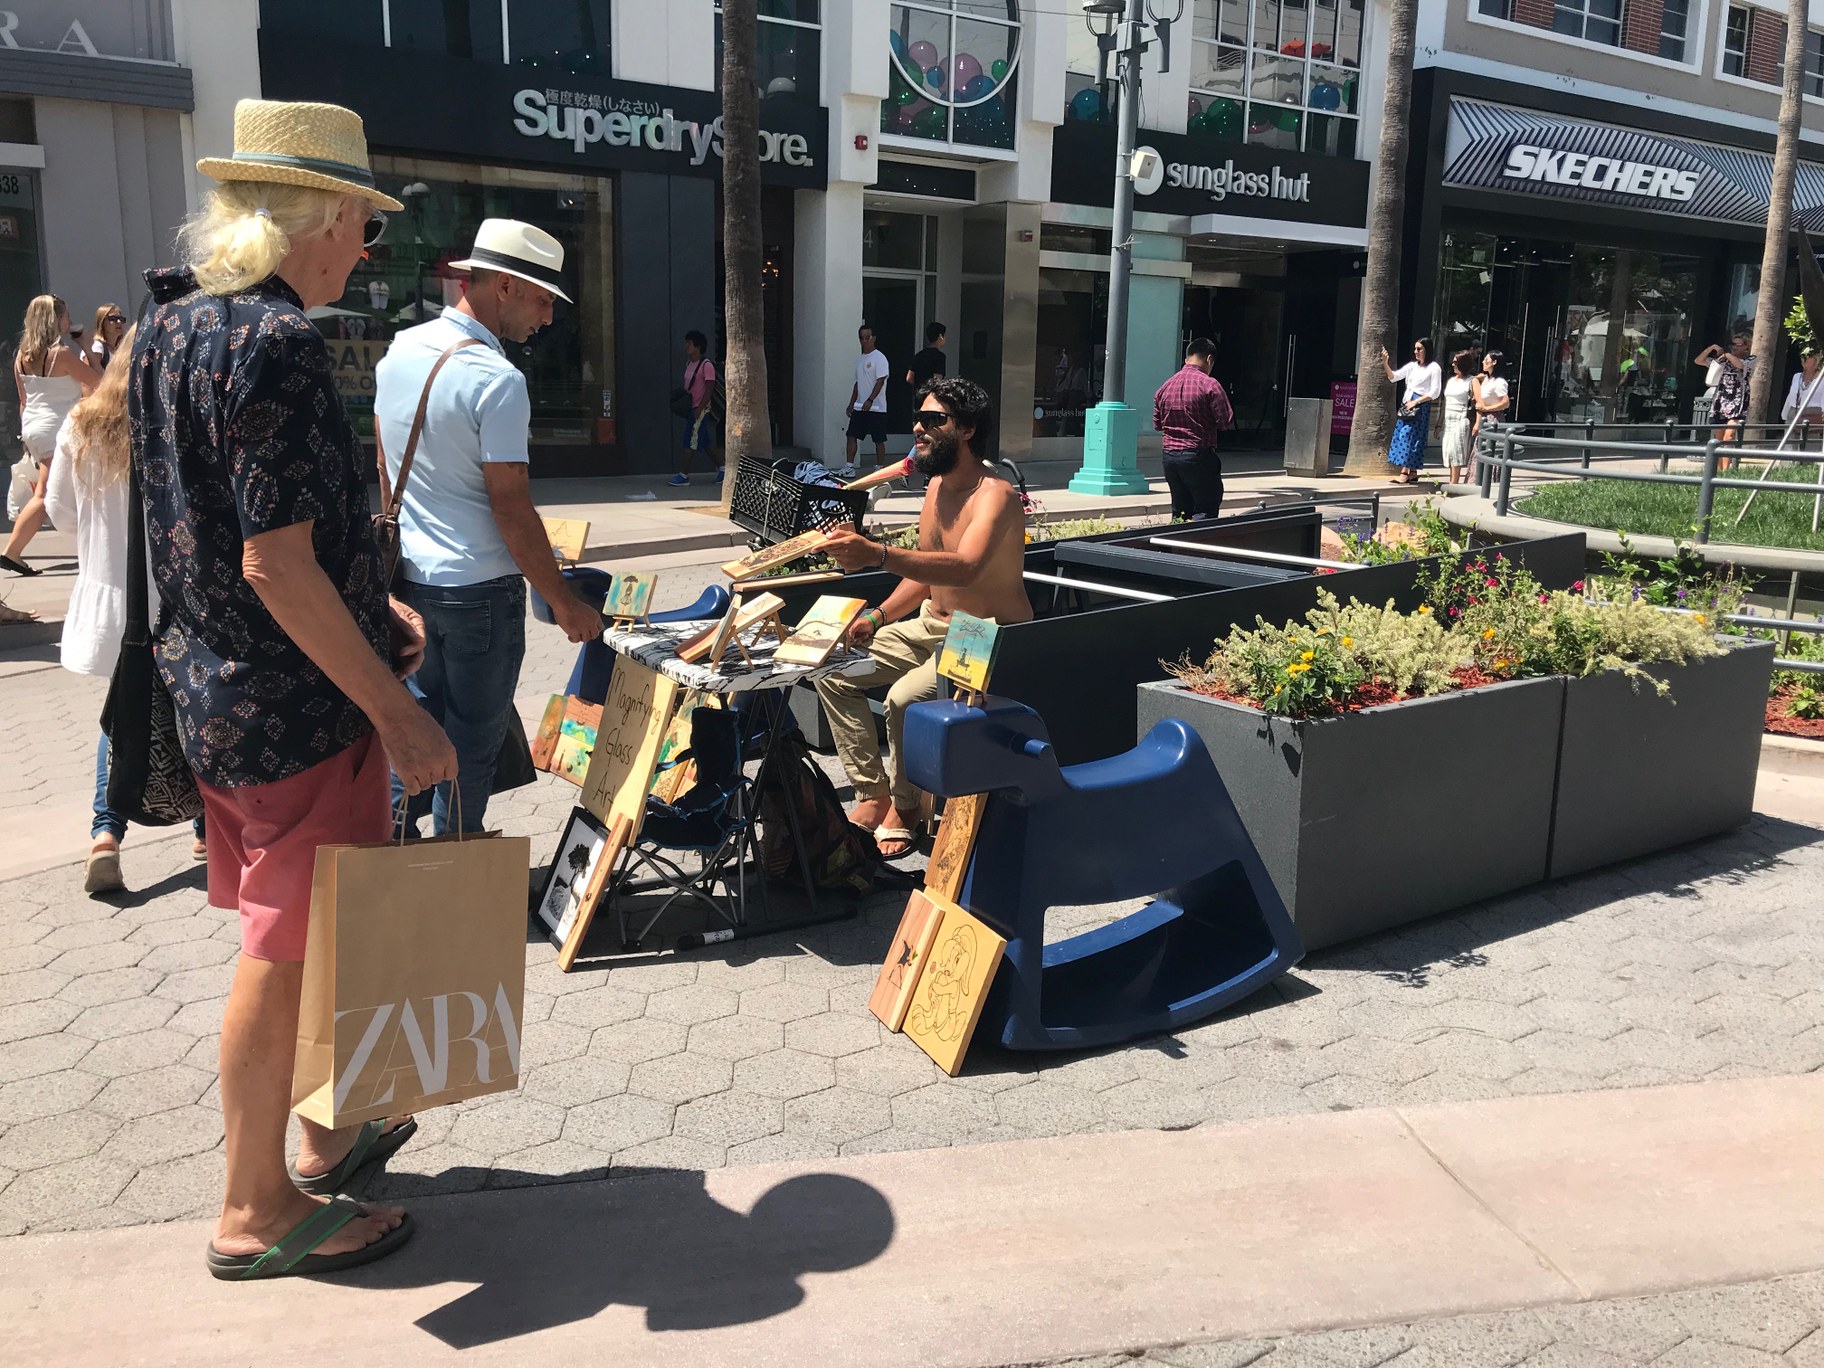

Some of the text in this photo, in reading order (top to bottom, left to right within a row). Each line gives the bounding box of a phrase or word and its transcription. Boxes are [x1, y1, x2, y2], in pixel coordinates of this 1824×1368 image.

[513, 88, 814, 167] Superdry ore.
[0, 175, 20, 195] 38
[1166, 158, 1311, 203] sunglass hut
[1503, 144, 1701, 203] SKECHERS
[326, 345, 389, 372] SAL
[1045, 407, 1085, 418] sunglass hu
[1334, 397, 1355, 408] SALE
[606, 666, 662, 736] Magnifying
[605, 726, 634, 768] Glass
[593, 770, 617, 810] Art
[334, 980, 521, 1116] ZARA
